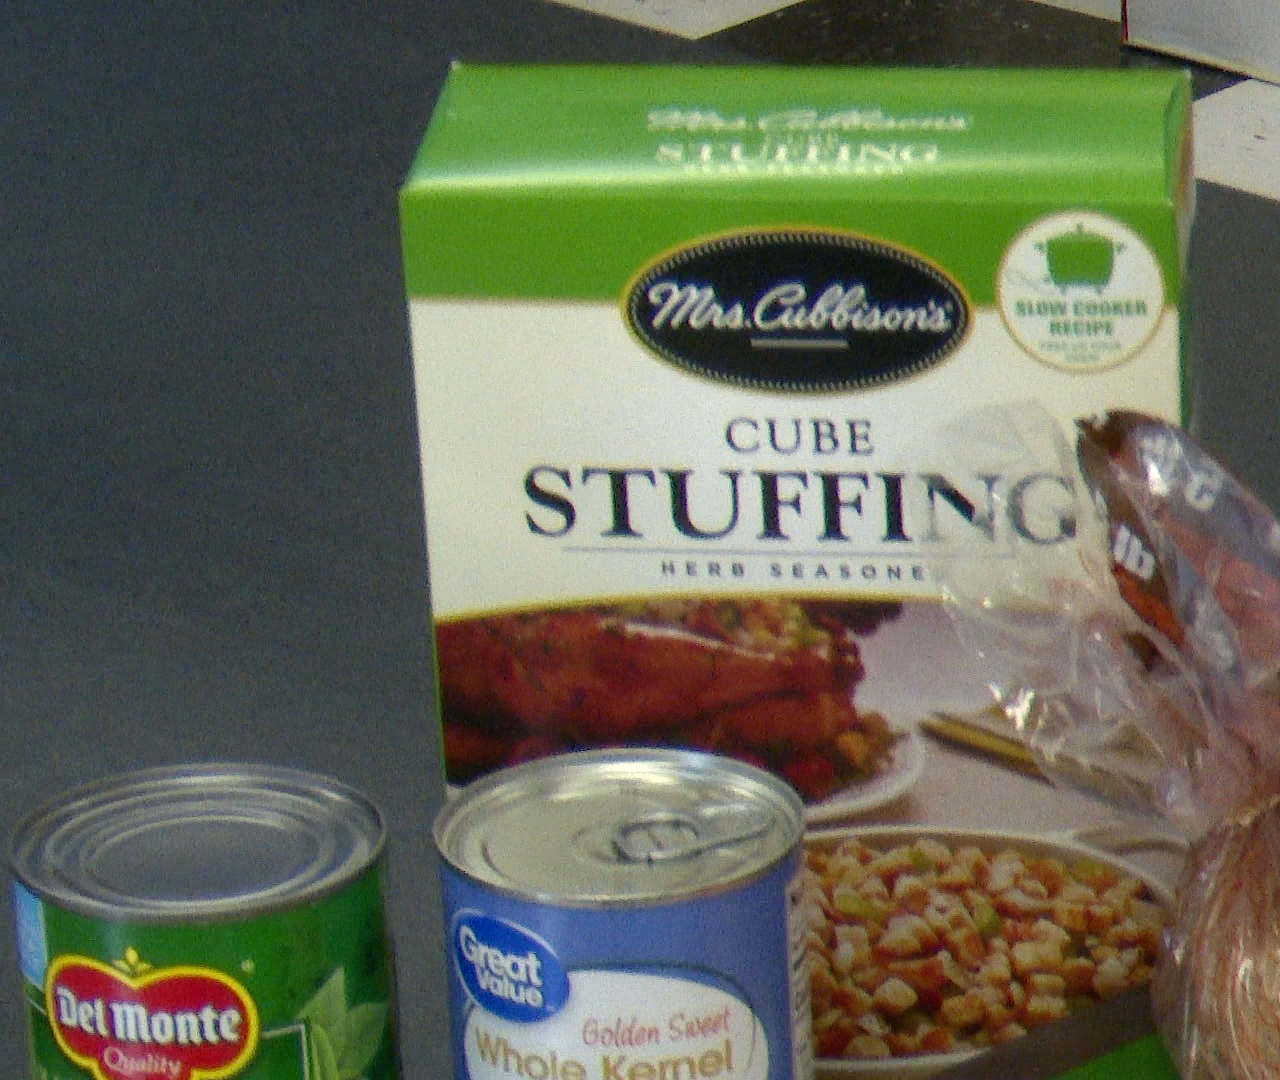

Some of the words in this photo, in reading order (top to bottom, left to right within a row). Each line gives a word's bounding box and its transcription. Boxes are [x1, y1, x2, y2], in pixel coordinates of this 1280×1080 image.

[1016, 300, 1067, 317] SLOW
[1072, 300, 1147, 317] COOKER
[1050, 319, 1114, 337] RECIPE
[724, 417, 873, 455] CUBE
[524, 465, 1076, 545] STUFFING
[661, 560, 745, 578] HERB
[770, 561, 926, 582] SEASONE
[459, 923, 543, 987] Great
[476, 967, 544, 1008] Value
[55, 986, 106, 1037] Del
[112, 1000, 243, 1045] Monte
[582, 1016, 661, 1049] Golden
[668, 1004, 732, 1042] Sweet
